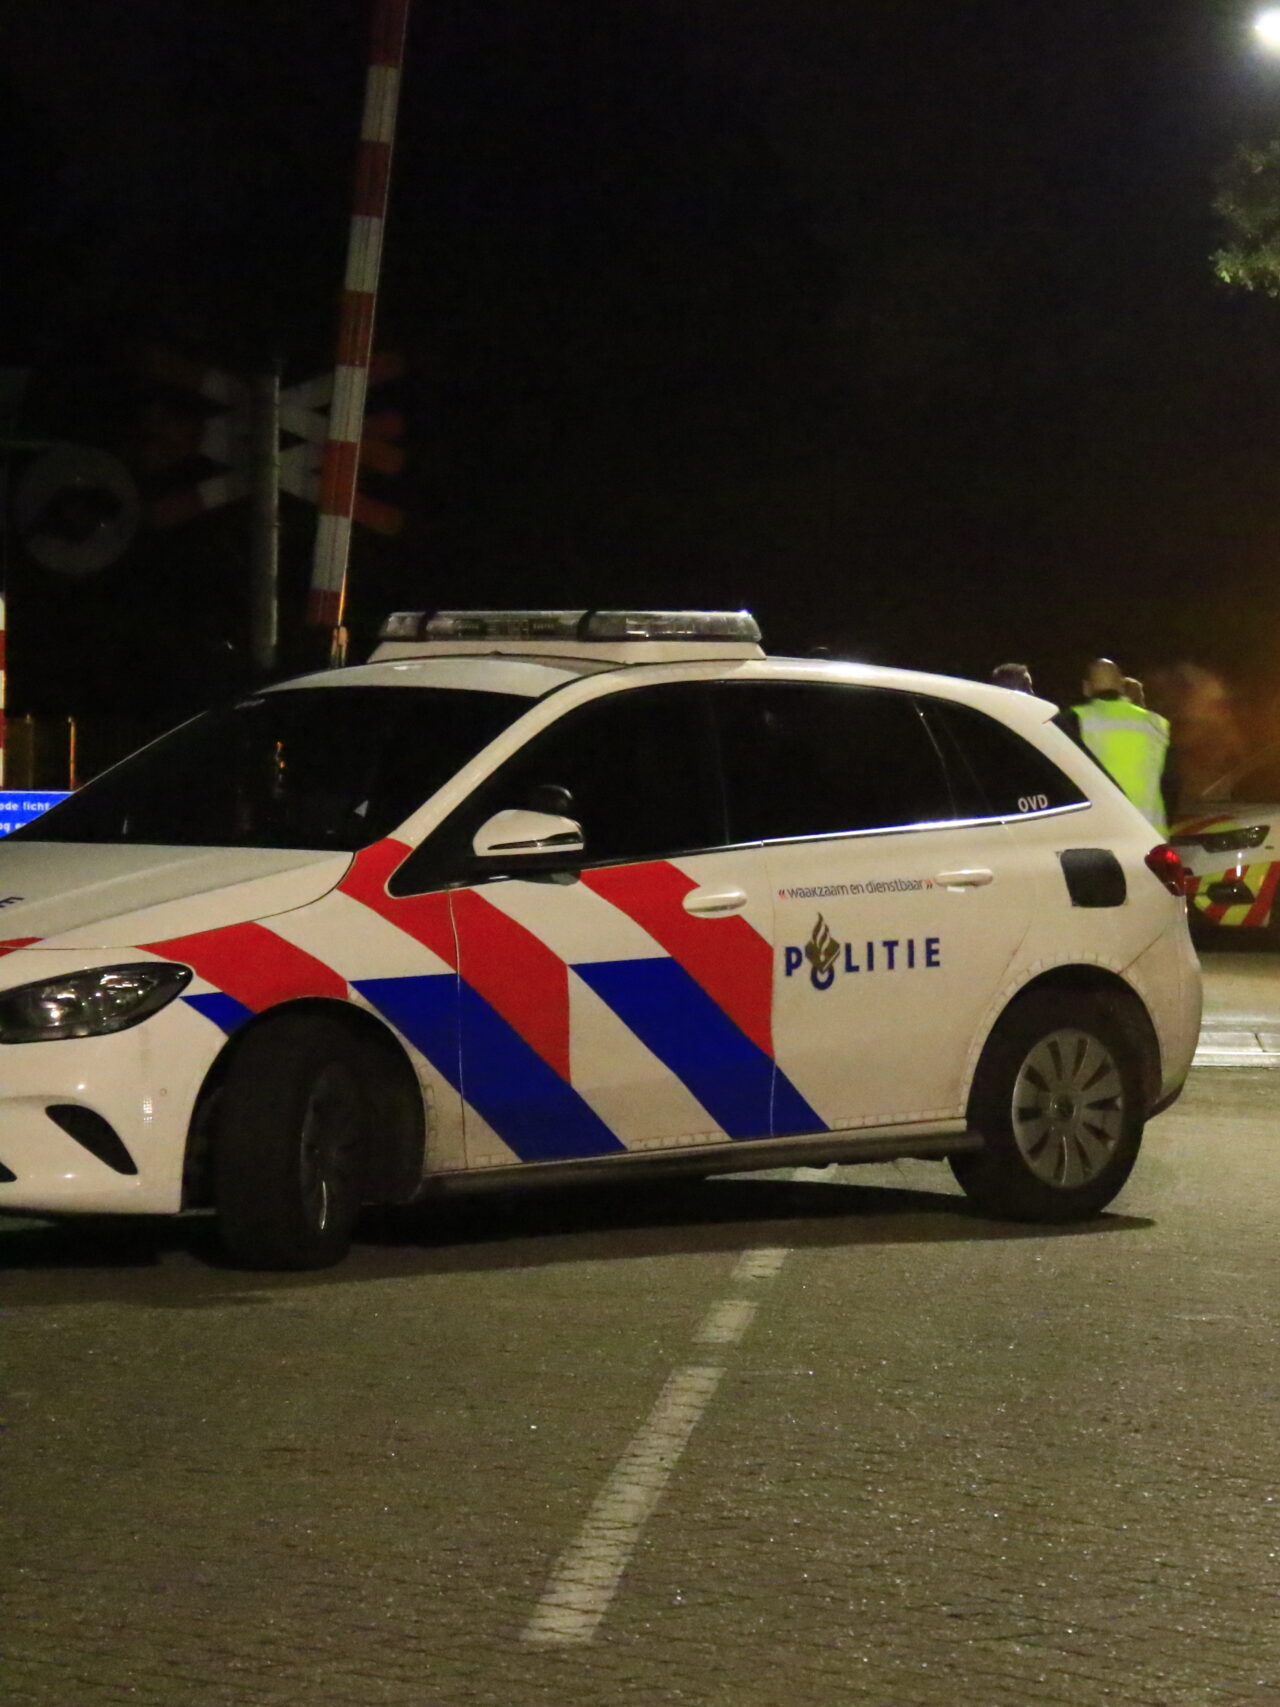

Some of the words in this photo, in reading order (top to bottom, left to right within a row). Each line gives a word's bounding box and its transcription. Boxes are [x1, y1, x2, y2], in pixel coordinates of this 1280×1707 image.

[22, 801, 51, 811] licht
[1017, 794, 1048, 812] OVD
[850, 882, 864, 895] en
[785, 937, 940, 991] POLITIE
